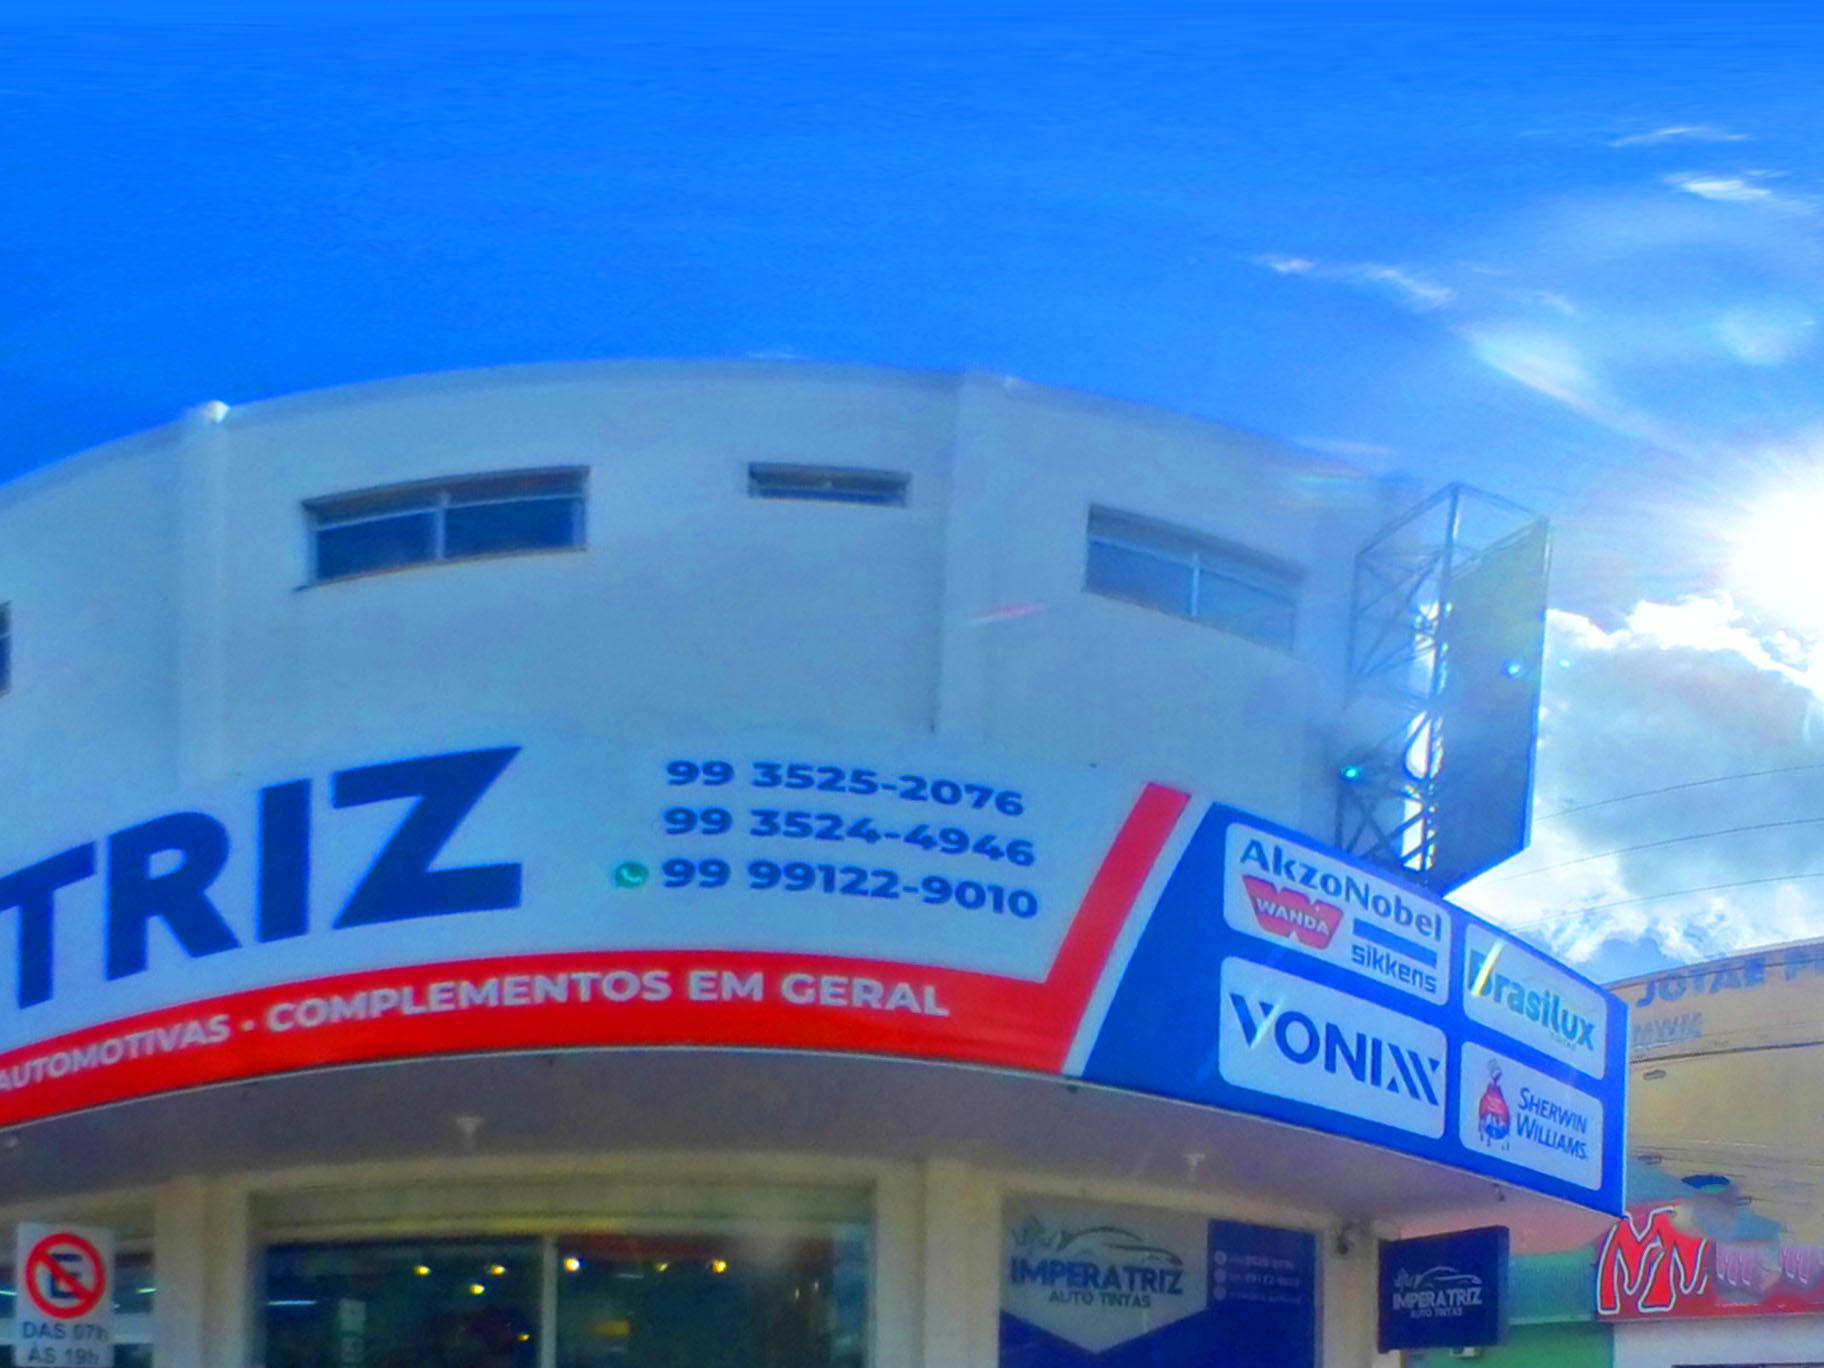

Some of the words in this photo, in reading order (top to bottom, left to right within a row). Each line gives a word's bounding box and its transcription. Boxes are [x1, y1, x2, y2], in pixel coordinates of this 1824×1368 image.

[665, 760, 734, 786] 99
[751, 761, 1025, 817] 3525-2076
[663, 807, 732, 835] 99
[749, 808, 1035, 867] 3524-4946
[662, 858, 730, 888] 99
[747, 859, 1038, 919] 99122-9010
[1240, 838, 1443, 942] AkzoNobel
[1256, 898, 1331, 935] WANDA
[1350, 943, 1439, 994] sikkens
[266, 970, 672, 1033] COMPLEMENTOS
[688, 970, 764, 1001] EM
[780, 974, 950, 1017] GERAL
[1518, 1087, 1588, 1134] SHERWIN
[1517, 1112, 1589, 1160] WILLIAMS
[1010, 1256, 1184, 1296] IMPERATRIZ
[1048, 1290, 1094, 1305] AUTO
[1100, 1292, 1152, 1309] TINTAS
[1393, 1287, 1483, 1311] IMPERATRIZ
[22, 1320, 66, 1340] DAS
